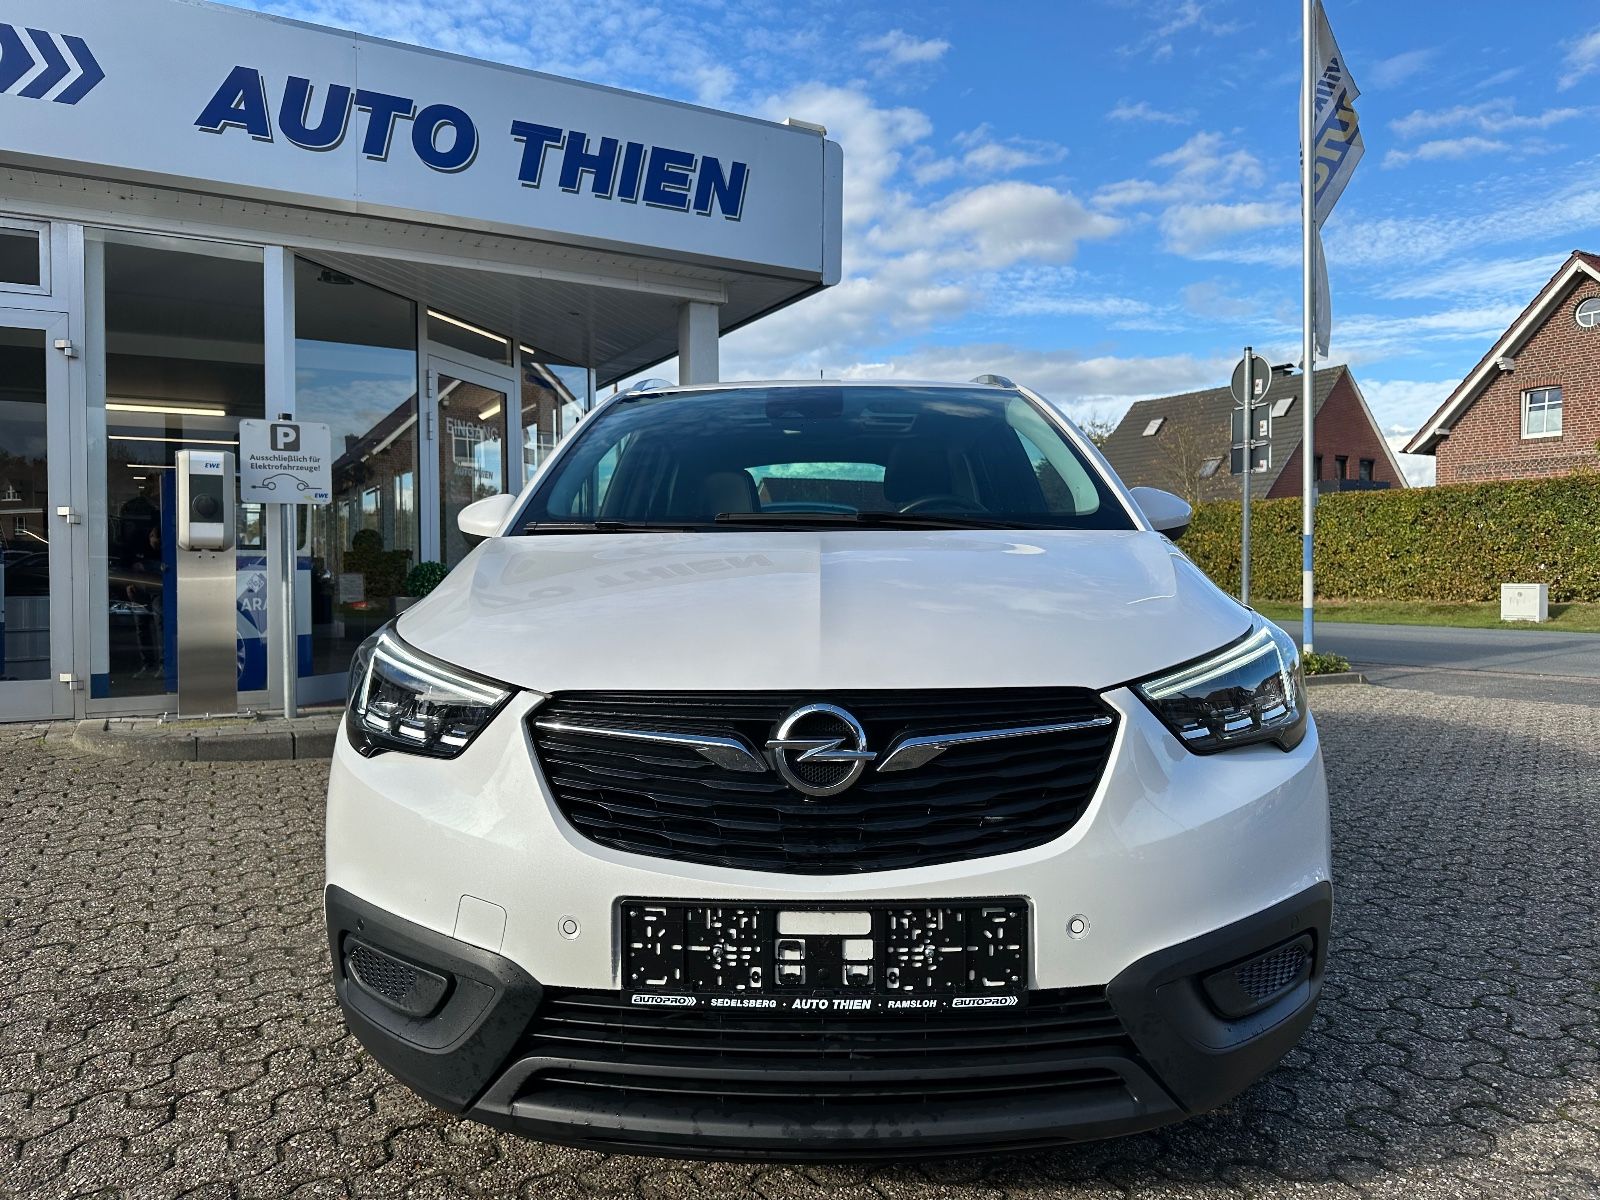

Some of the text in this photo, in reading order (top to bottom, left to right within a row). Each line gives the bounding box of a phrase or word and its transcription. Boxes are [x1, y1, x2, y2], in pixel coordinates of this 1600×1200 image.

[194, 65, 748, 222] AUTO THIEN
[446, 416, 499, 441] EINGANG
[276, 426, 297, 450] P
[249, 454, 321, 463] Ausschließlich für
[250, 462, 321, 473] Elektrofahrzeuge!
[710, 998, 777, 1008] SEDELSBERG
[791, 998, 829, 1009] AUTO
[832, 999, 872, 1010] THIEN
[887, 999, 938, 1008] RAMSLOH
